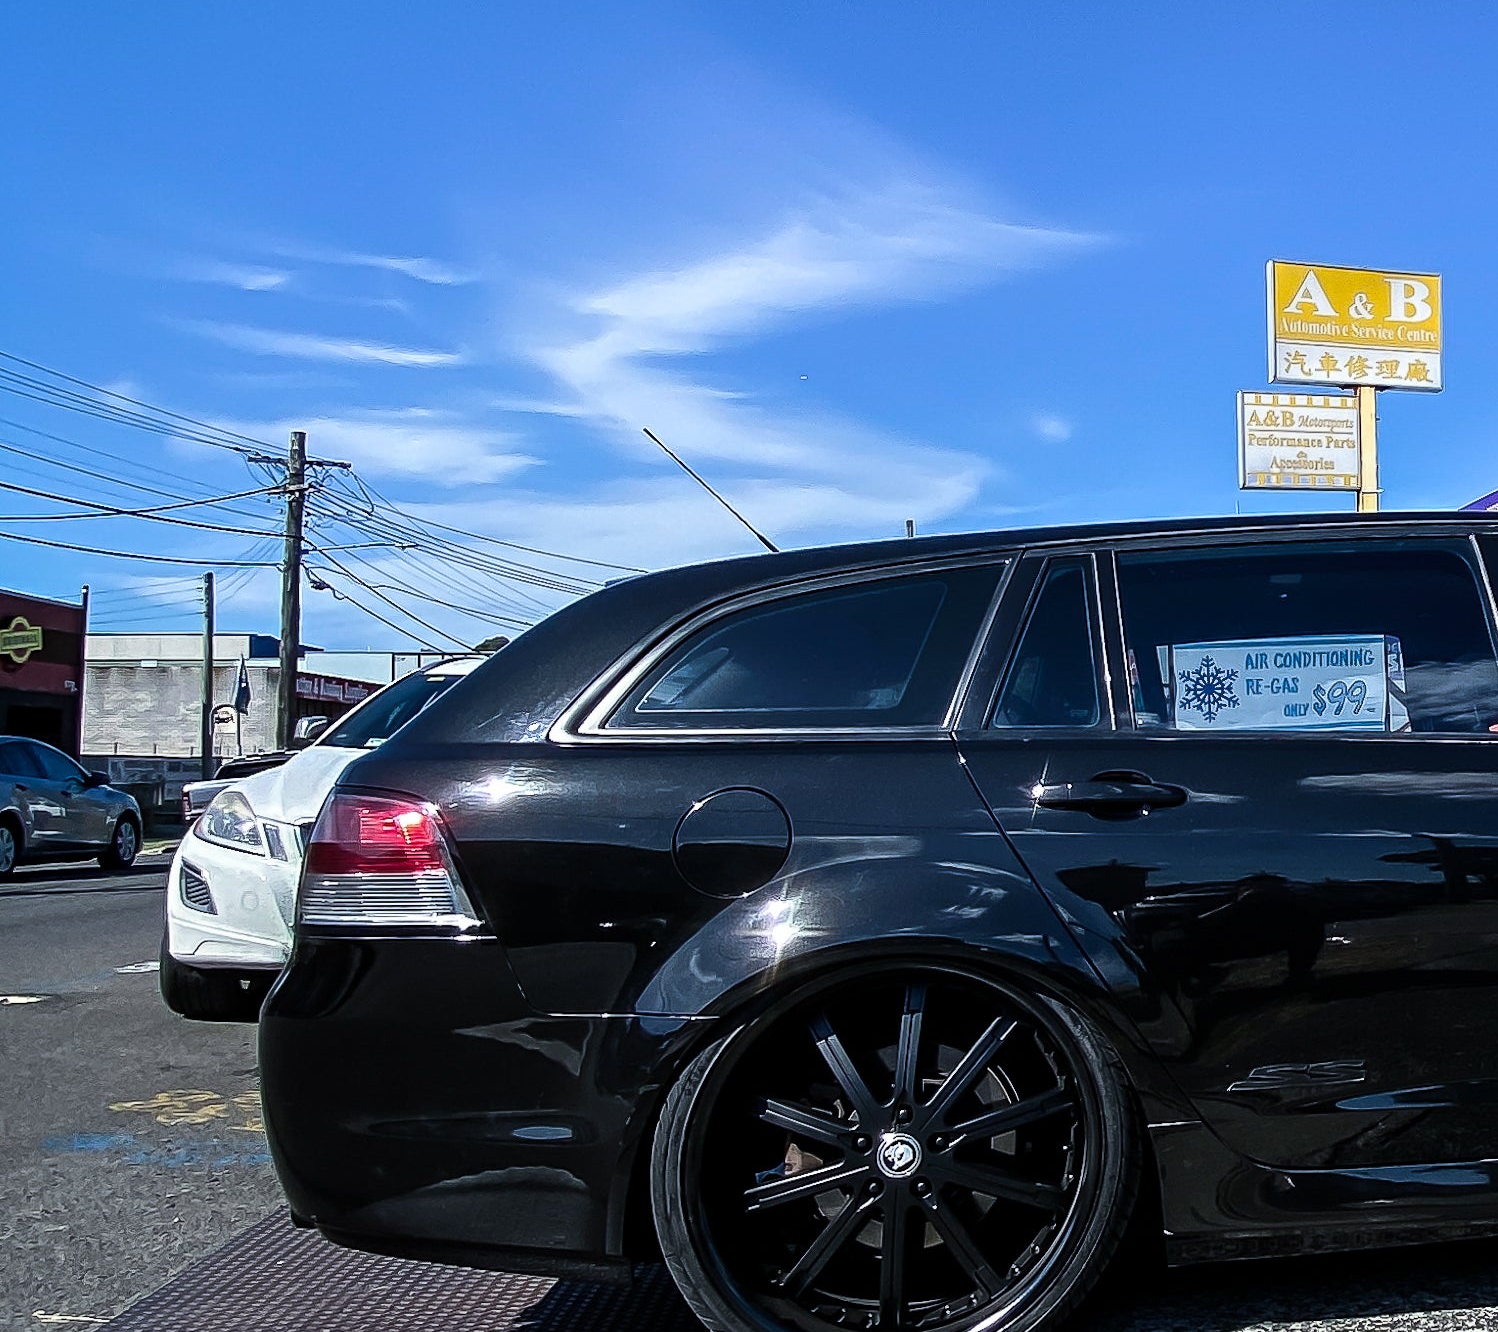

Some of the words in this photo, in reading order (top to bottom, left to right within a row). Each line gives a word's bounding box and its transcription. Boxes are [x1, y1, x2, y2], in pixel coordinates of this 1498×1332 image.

[1283, 269, 1340, 317] A
[1349, 293, 1375, 319] &
[1384, 278, 1433, 323] B
[1281, 317, 1348, 338] Automotive
[1350, 321, 1393, 340] Service
[1397, 326, 1438, 343] Centre
[1284, 350, 1434, 382] 汽車修理廠
[1247, 410, 1296, 427] A&B
[1298, 415, 1354, 433] Motorsports
[1248, 433, 1323, 447] Performance
[1325, 436, 1356, 448] Parts
[1245, 652, 1269, 670] AIR
[1273, 648, 1376, 669] CONDITIONING
[1246, 677, 1300, 696] RE-GAS
[1283, 703, 1310, 718] ONLY
